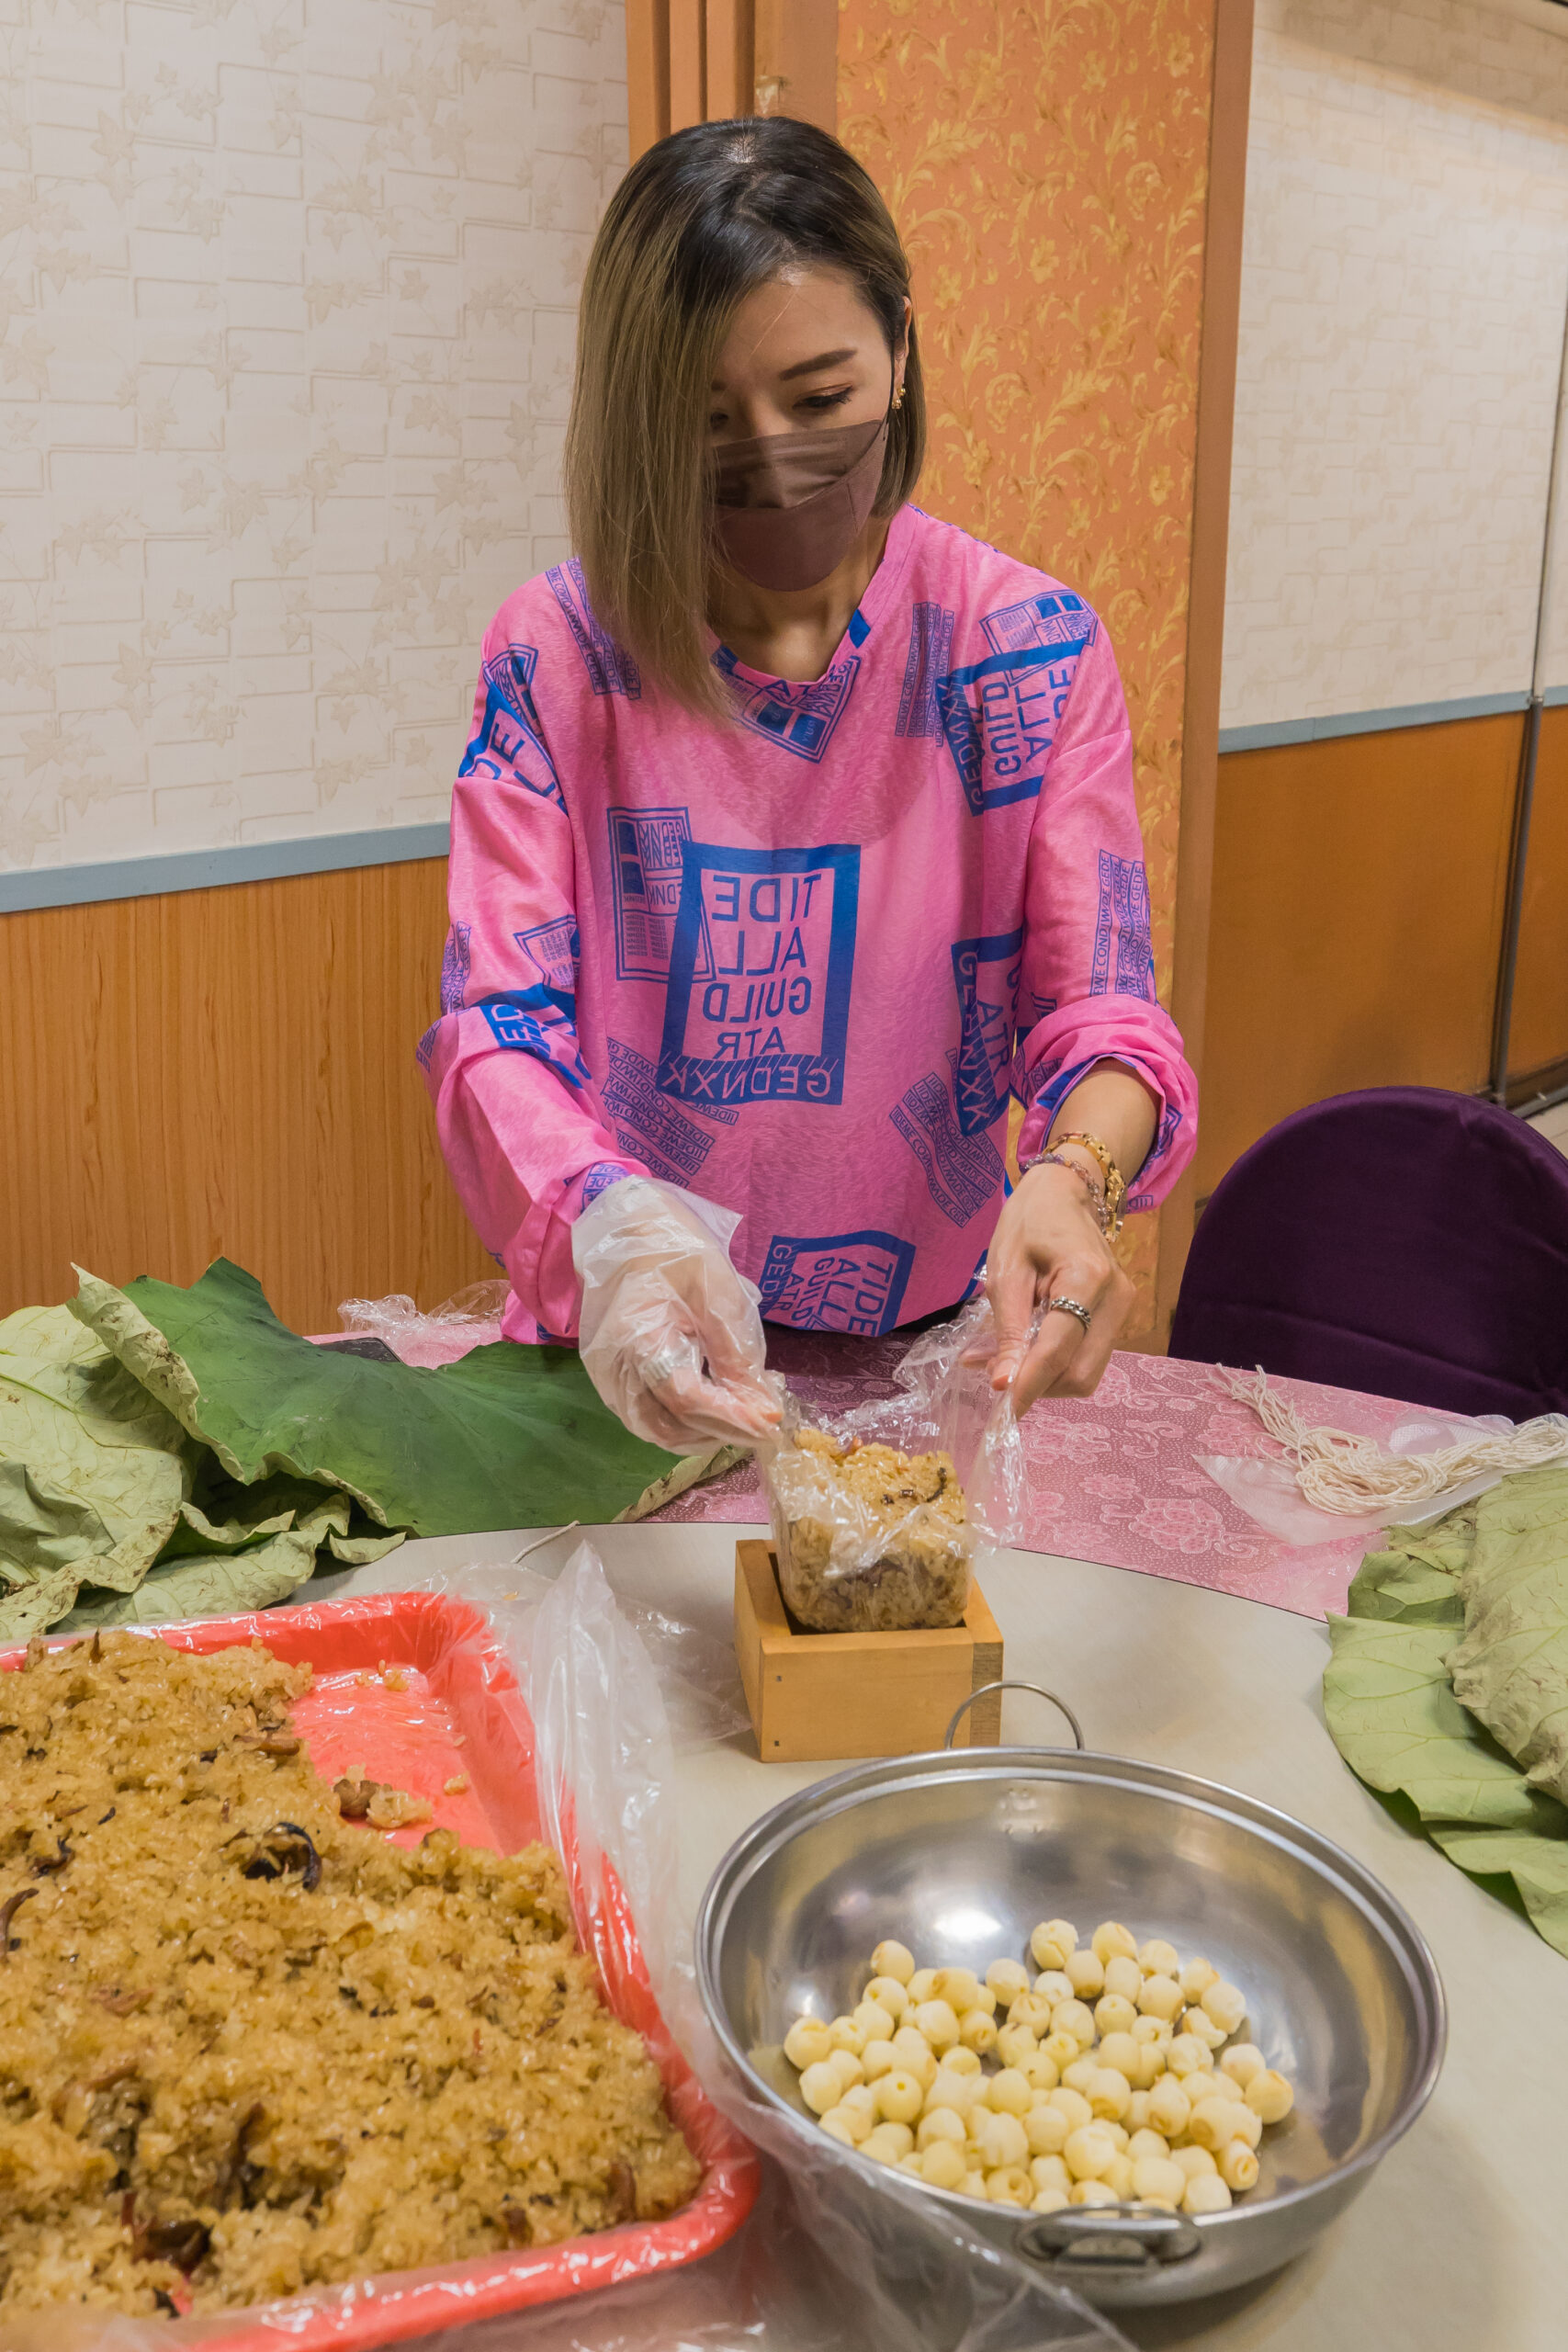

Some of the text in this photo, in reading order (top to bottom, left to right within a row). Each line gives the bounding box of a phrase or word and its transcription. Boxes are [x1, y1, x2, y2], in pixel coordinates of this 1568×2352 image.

[772, 1272, 805, 1312] ATR
[791, 1256, 836, 1321] GUILD
[818, 1258, 861, 1316] ALL
[847, 1261, 894, 1337] TIDE
